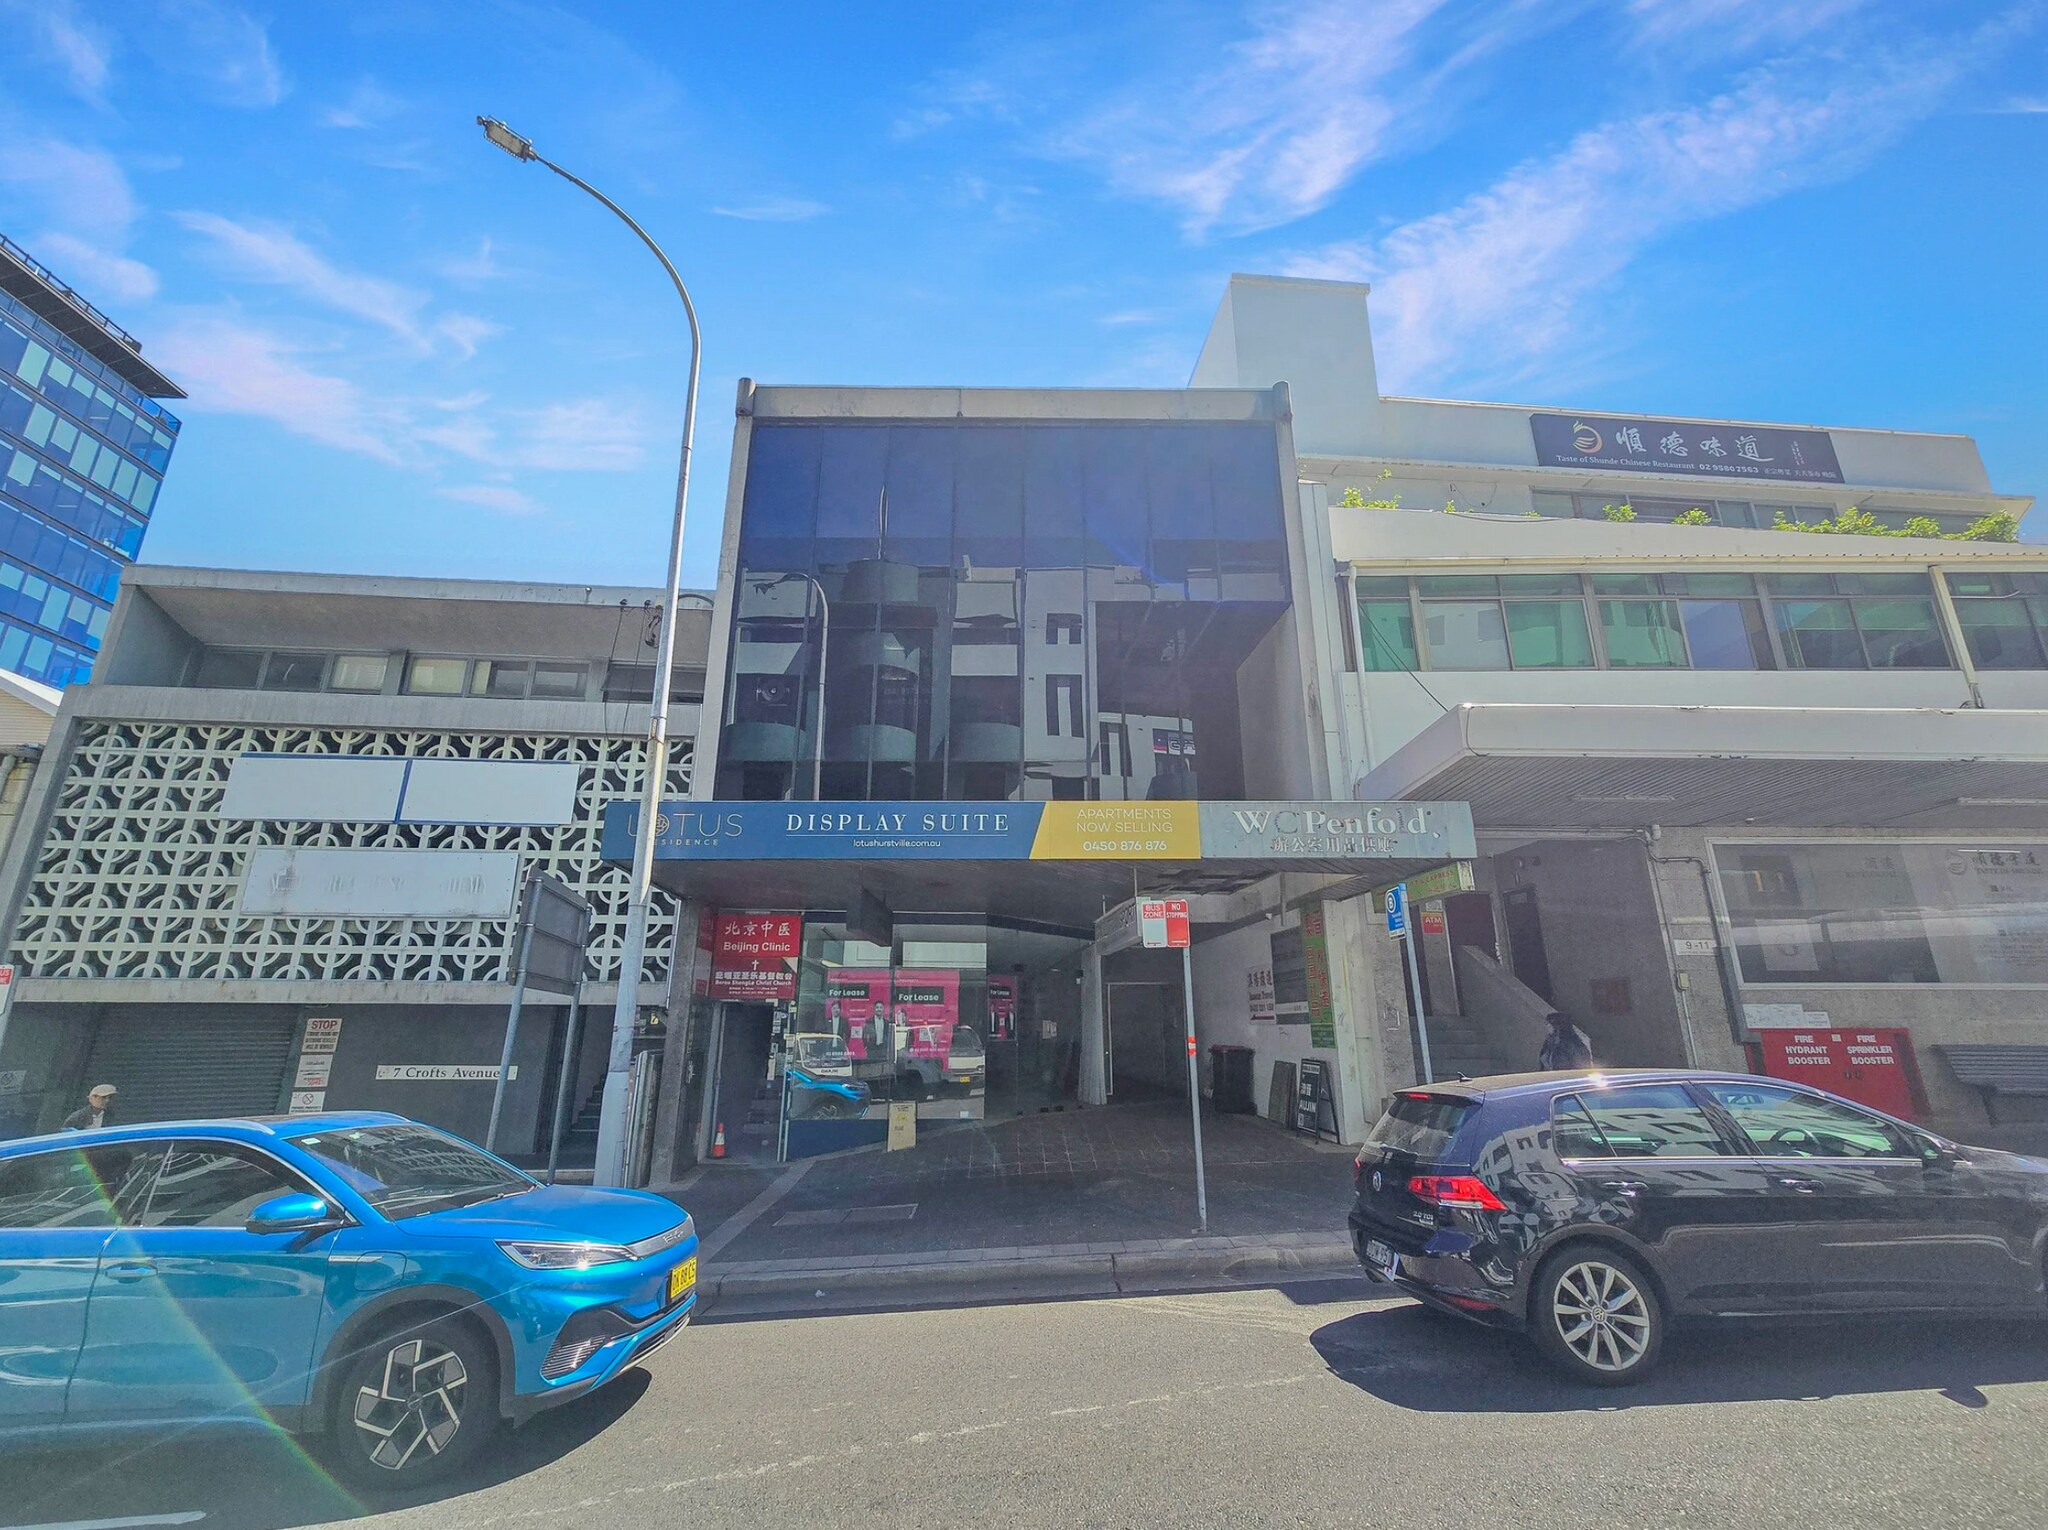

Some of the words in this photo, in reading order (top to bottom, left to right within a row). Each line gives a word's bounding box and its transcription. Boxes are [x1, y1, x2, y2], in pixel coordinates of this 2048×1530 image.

[1580, 455, 1588, 463] of
[1589, 457, 1619, 465] Shunde
[1621, 459, 1651, 467] Chinese
[1653, 461, 1694, 470] Restaurant
[1077, 809, 1172, 819] APARTMENTS
[786, 814, 908, 831] DISPLAY
[923, 814, 1009, 831] SUITE
[1076, 822, 1112, 833] NOW
[1115, 822, 1173, 833] SELLING
[853, 838, 941, 847] lotushurstville.com.au
[1083, 840, 1117, 851] 0450
[1120, 840, 1142, 851] 876
[1146, 840, 1167, 851] 876
[1171, 903, 1181, 911] NO
[725, 921, 790, 937] 北京中医
[723, 941, 759, 953] Beijing
[762, 942, 790, 952] Clinic
[842, 989, 865, 997] Lease
[899, 993, 913, 1001] For
[311, 1020, 338, 1030] STOP
[1794, 1035, 1815, 1043] FIRE
[1856, 1035, 1877, 1043] FIRE
[1785, 1046, 1828, 1054] HYDRANT
[1846, 1046, 1893, 1054] SPRINKLER
[1787, 1057, 1831, 1065] BOOSTER
[1851, 1056, 1895, 1065] BOOSTER
[393, 1067, 401, 1077] 7
[406, 1067, 447, 1078] Crofts
[452, 1067, 500, 1078] Avenue
